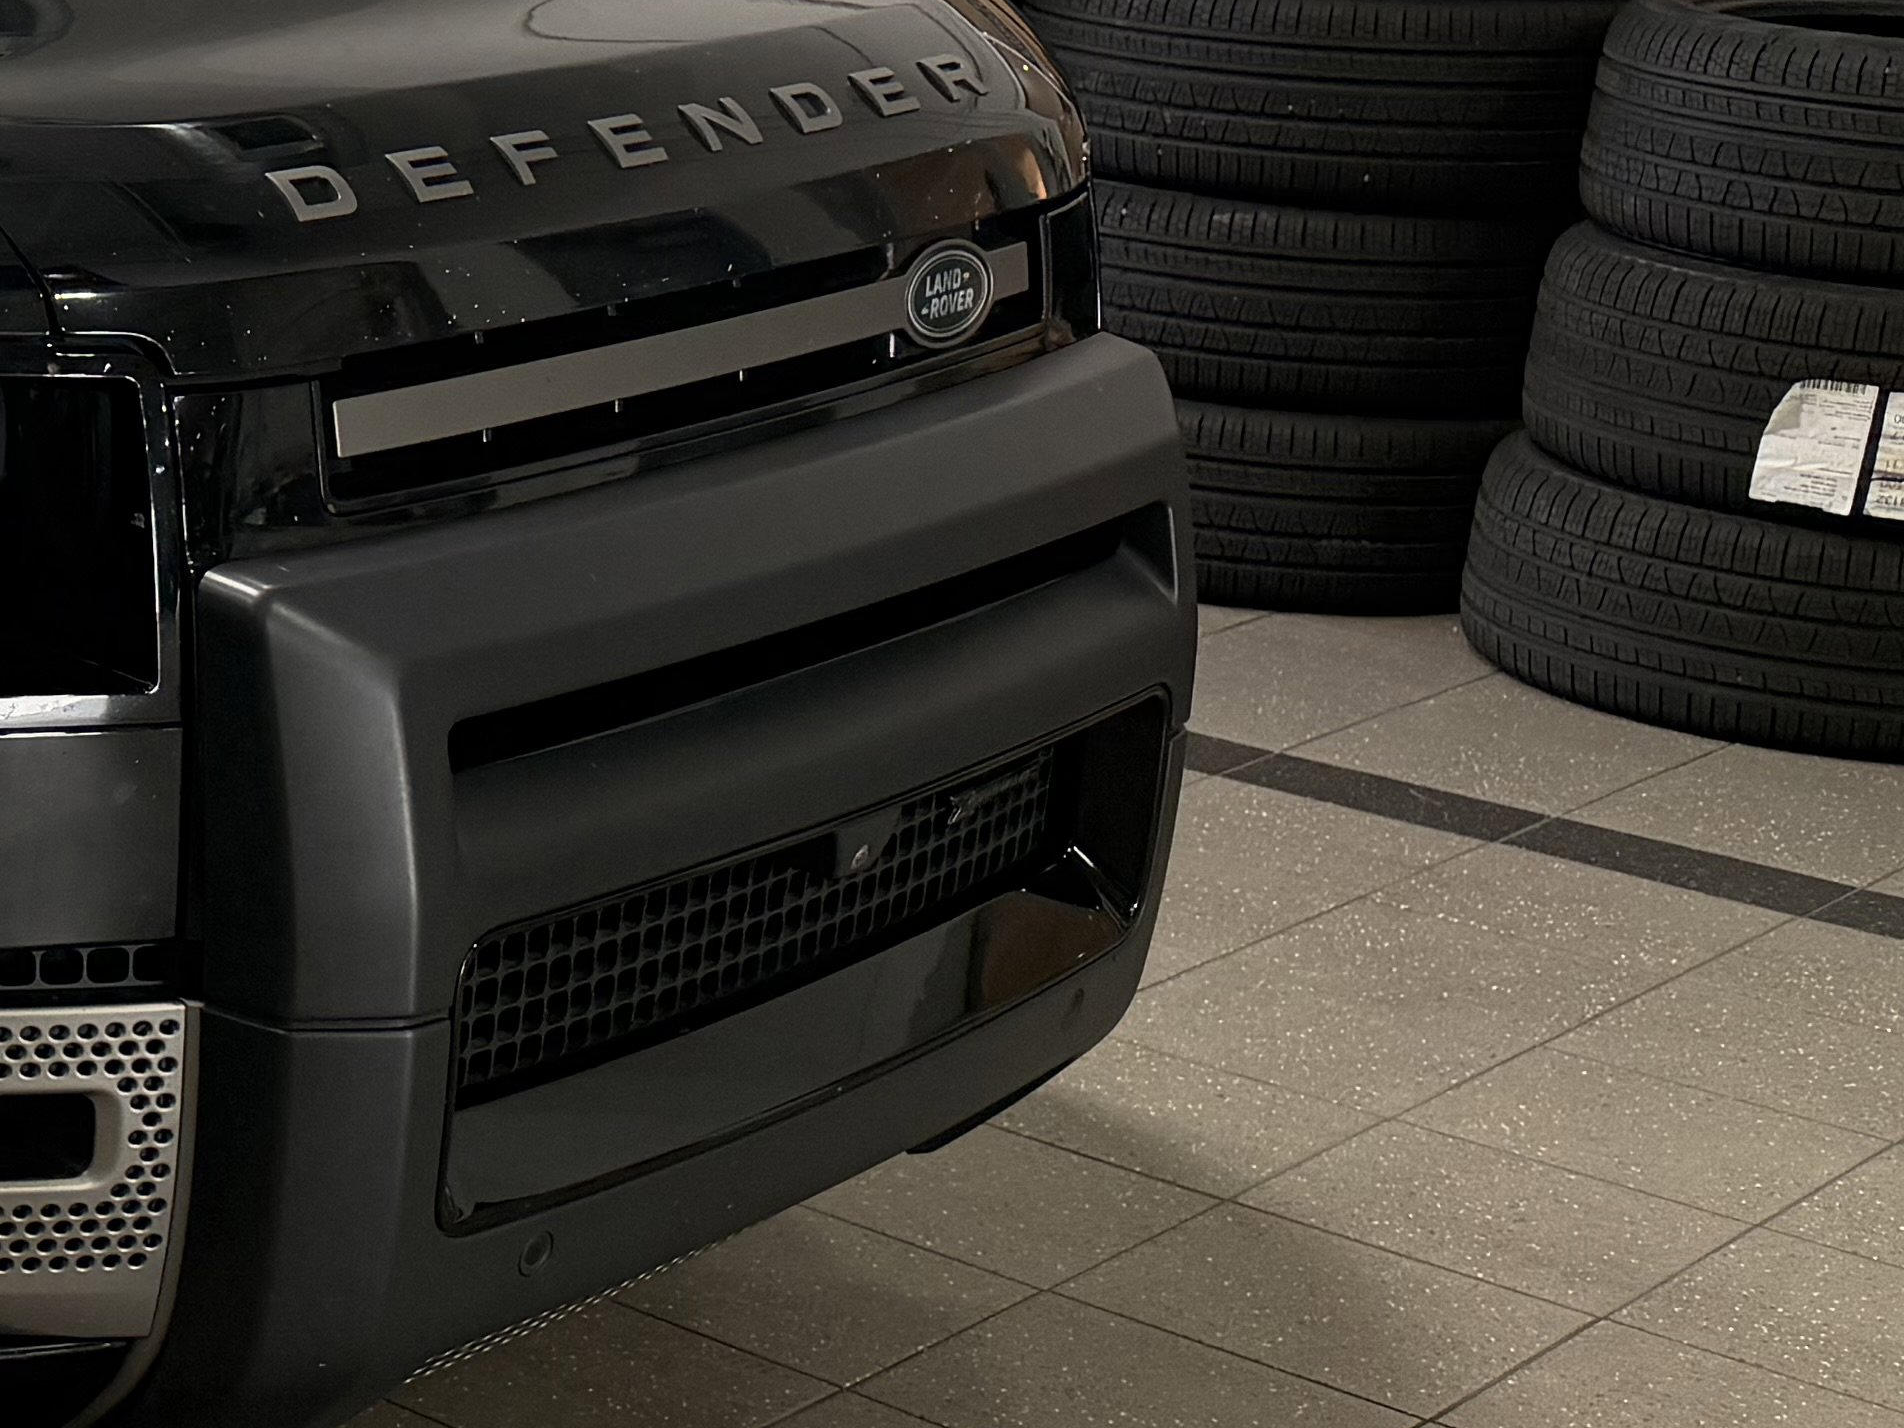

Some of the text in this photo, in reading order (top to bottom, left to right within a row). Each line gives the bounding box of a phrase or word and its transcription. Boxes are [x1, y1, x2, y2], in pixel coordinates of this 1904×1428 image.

[264, 53, 990, 223] DEFENDER
[925, 268, 962, 298] LAND
[929, 287, 974, 320] ROVER
